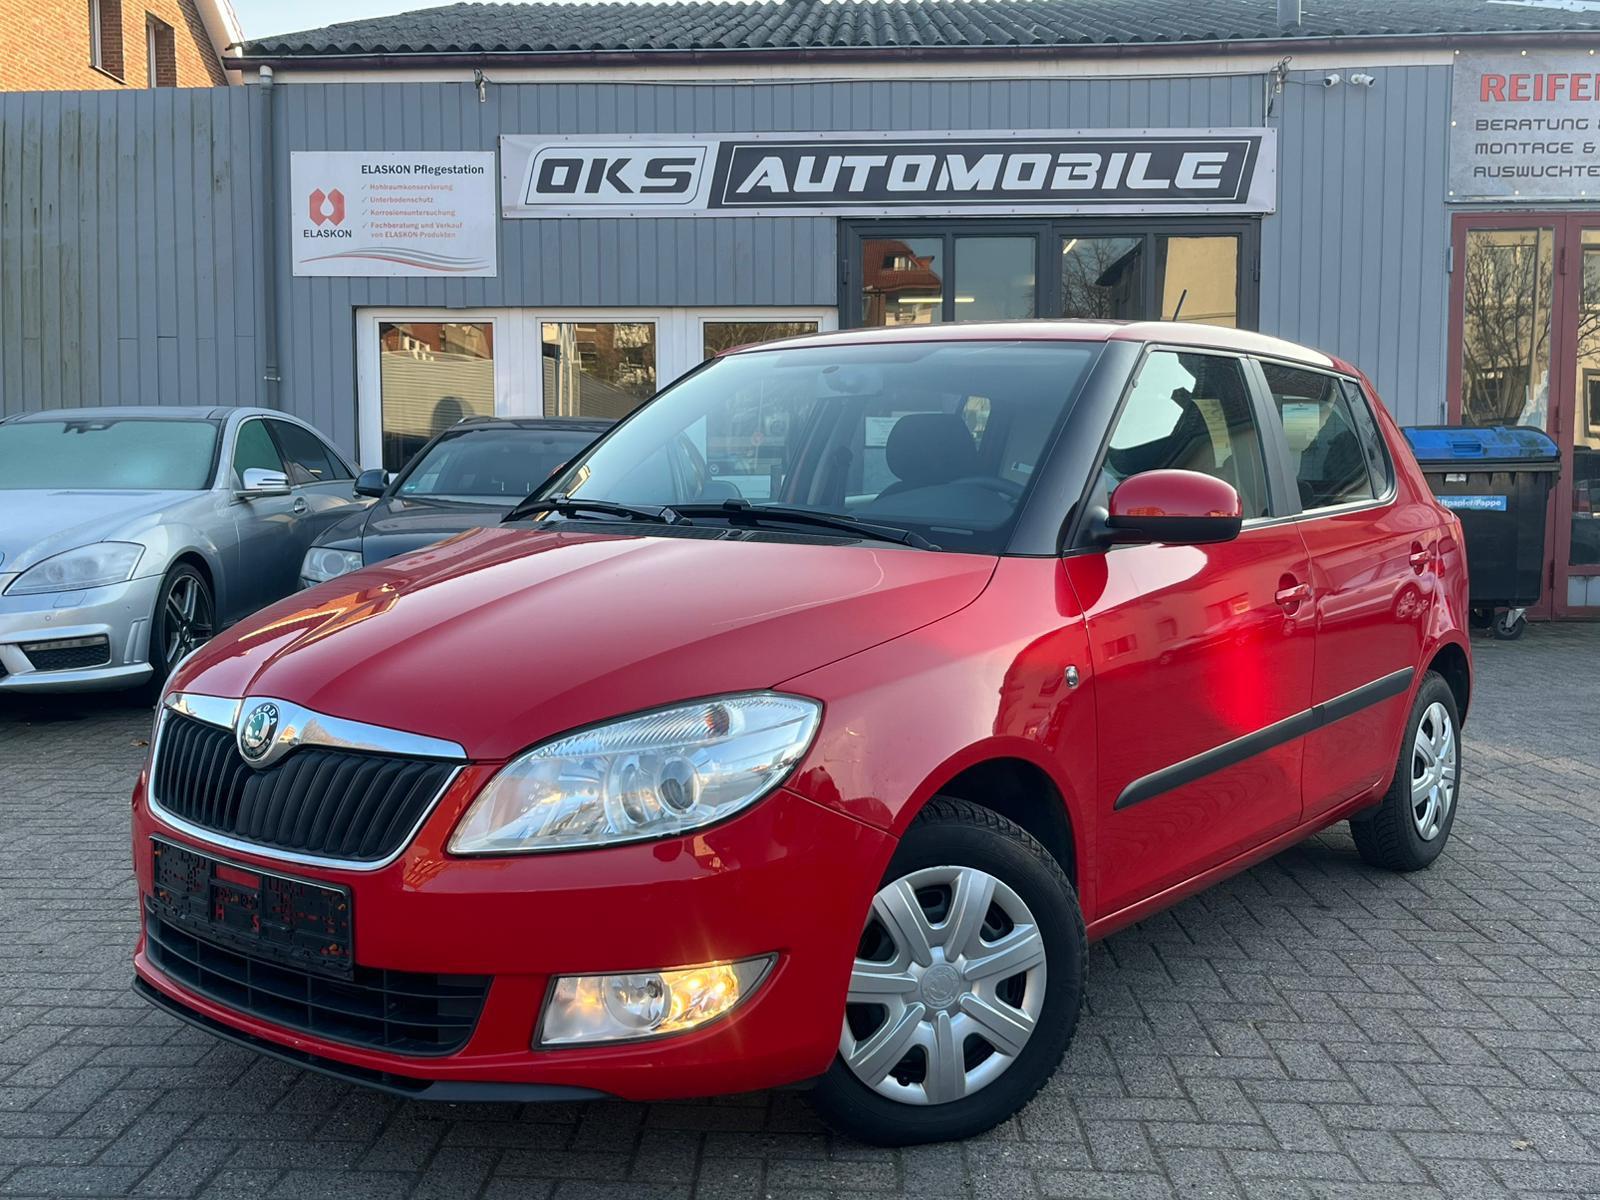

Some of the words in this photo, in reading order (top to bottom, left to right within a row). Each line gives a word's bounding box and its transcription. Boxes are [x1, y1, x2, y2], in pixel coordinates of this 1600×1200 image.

[1480, 73, 1600, 102] REIFE
[1475, 118, 1589, 131] BERATUNG
[1474, 142, 1574, 155] MONTAGE
[1582, 142, 1597, 154] &
[361, 164, 411, 175] ELASKON
[414, 163, 485, 177] Pflegestation
[535, 157, 697, 194] OKS
[735, 151, 1229, 194] AUTOMOBILE
[1473, 165, 1600, 178] AUSWUCHTE
[369, 183, 454, 192] Hohlraumkonservierung
[369, 196, 434, 204] Unterbodenschutz
[370, 209, 456, 217] Korrosionsuntersuchung
[370, 221, 420, 230] Fachberatung
[420, 221, 434, 229] und
[436, 221, 463, 229] Verkauf
[303, 229, 352, 239] ELASKON
